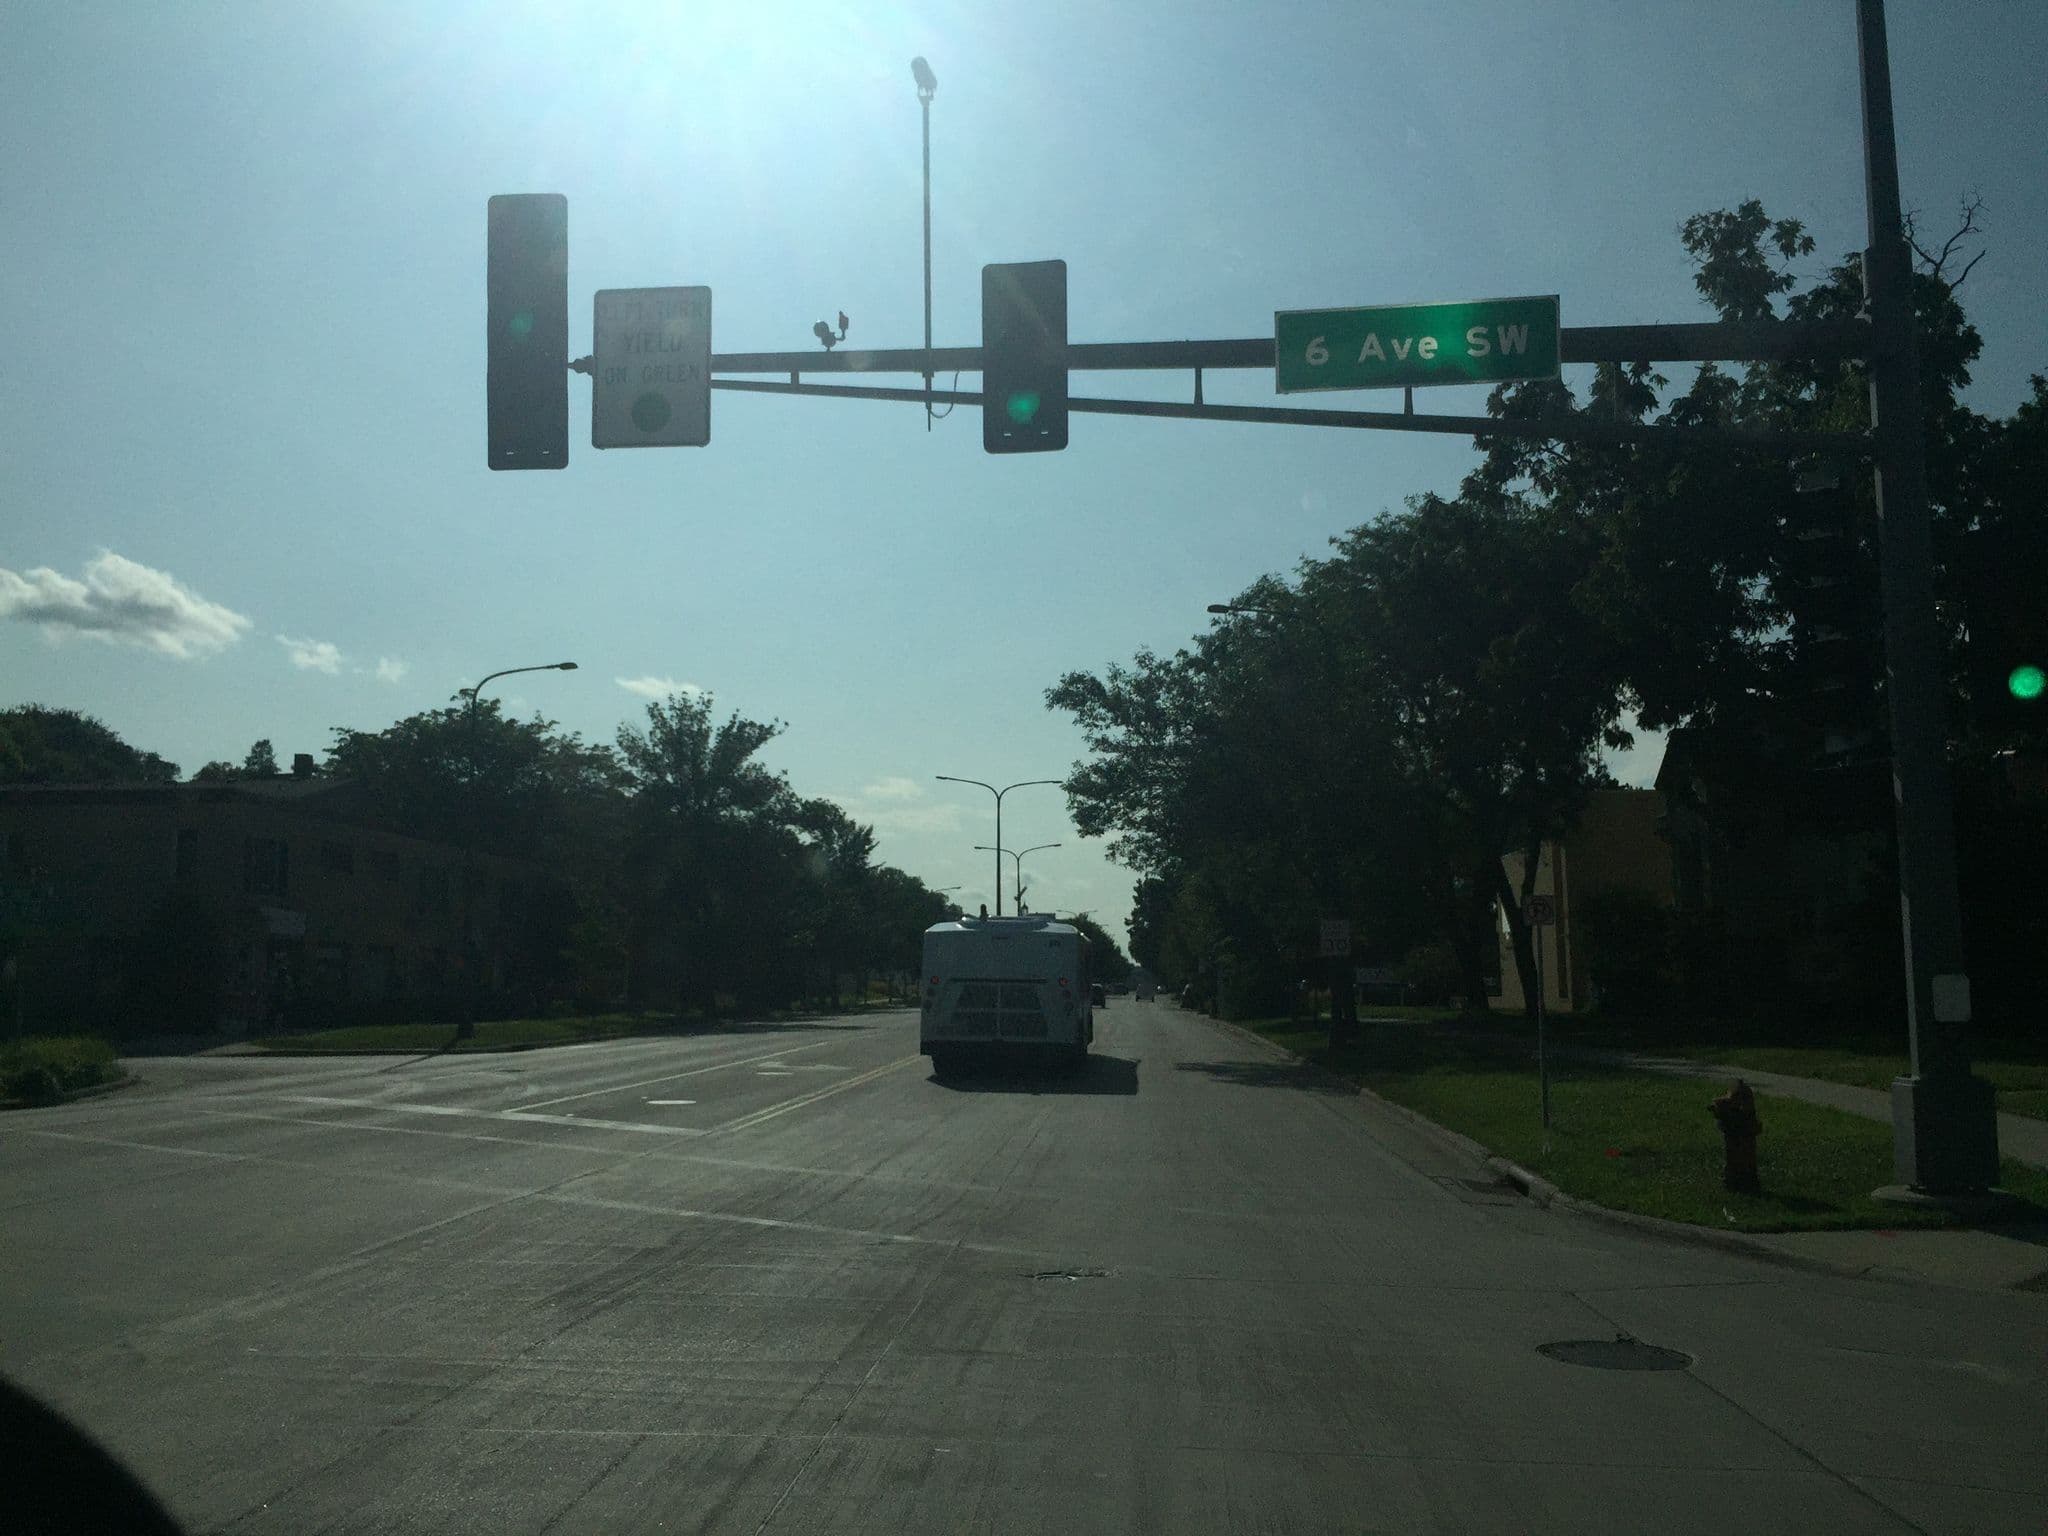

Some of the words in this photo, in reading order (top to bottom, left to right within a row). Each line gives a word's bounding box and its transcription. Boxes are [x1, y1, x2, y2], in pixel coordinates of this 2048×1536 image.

[1305, 336, 1329, 365] 6
[1357, 333, 1438, 363] Ave
[1466, 325, 1528, 357] SW
